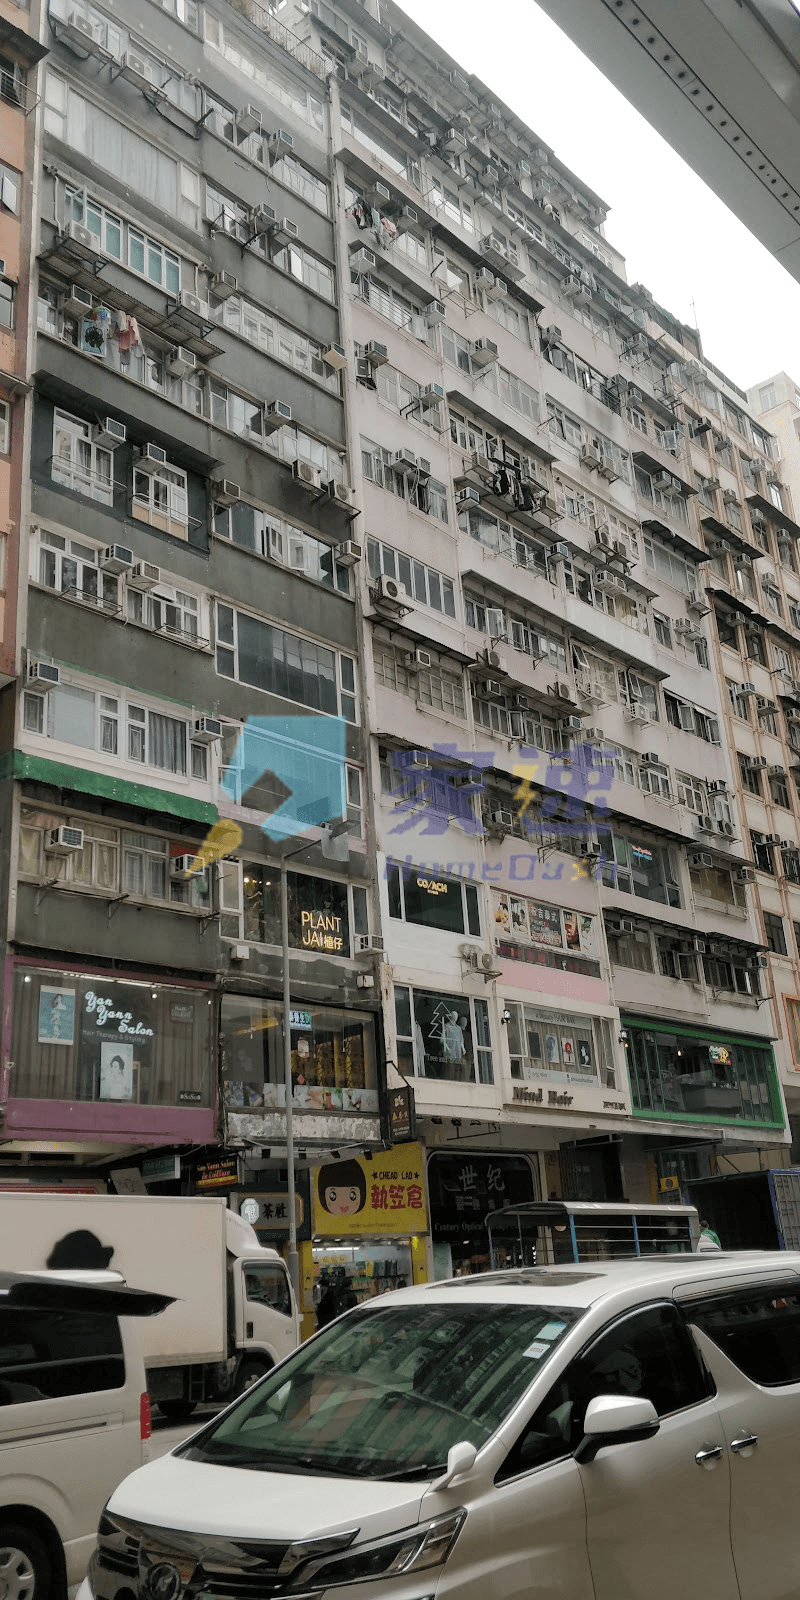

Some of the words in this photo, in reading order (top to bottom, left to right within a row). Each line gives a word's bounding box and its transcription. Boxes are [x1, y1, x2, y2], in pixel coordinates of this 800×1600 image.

[301, 911, 341, 933] PLANT
[303, 929, 323, 947] JAI
[85, 991, 113, 1013] Yan
[96, 1005, 133, 1026] Yann
[96, 1031, 118, 1040] Therapy
[118, 1019, 154, 1036] Salon
[512, 1086, 543, 1102] Mind
[371, 1184, 422, 1210] 執笠倉
[262, 1202, 288, 1220] 茶社
[434, 1223, 459, 1233] Century
